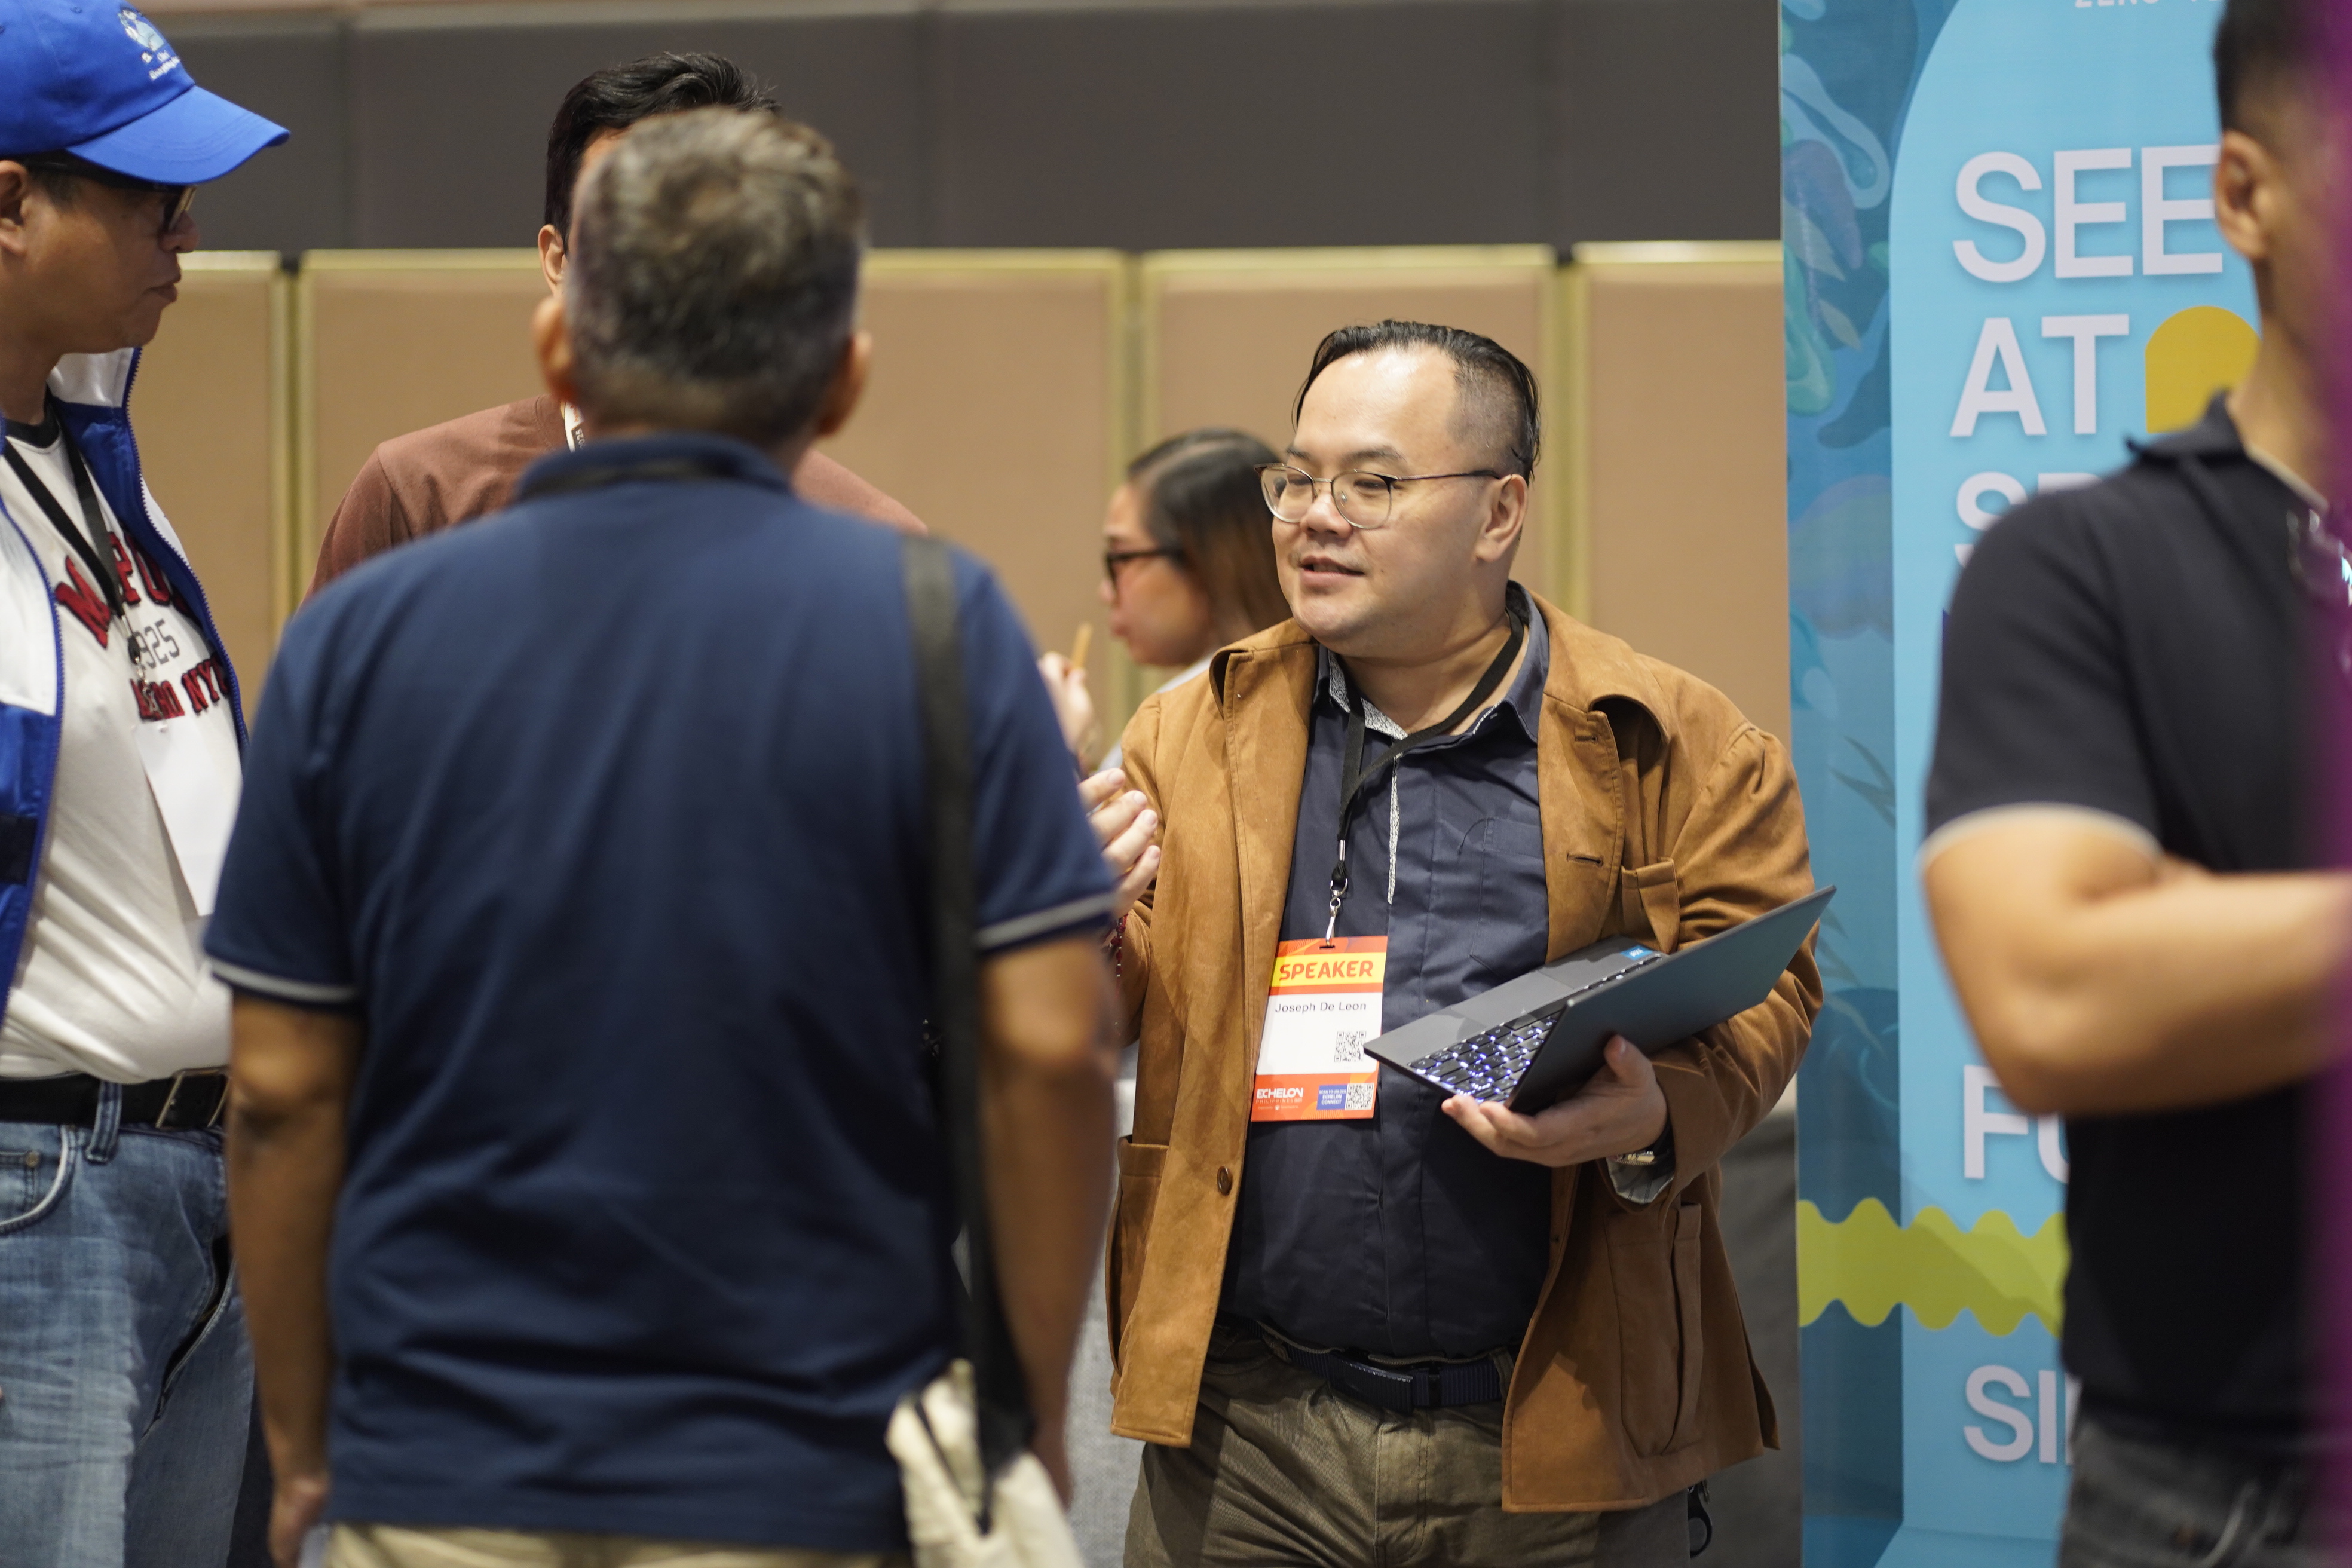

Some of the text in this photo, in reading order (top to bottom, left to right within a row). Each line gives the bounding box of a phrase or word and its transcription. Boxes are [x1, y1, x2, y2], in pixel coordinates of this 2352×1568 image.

[1953, 145, 2223, 283] SEE
[1950, 314, 2130, 437] AT
[133, 618, 180, 670] 925
[1279, 960, 1374, 981] SPEAKER
[1275, 1001, 1367, 1014] Joseph De Leon
[1256, 1087, 1304, 1099] ECHELON
[1964, 1364, 2083, 1466] SI
